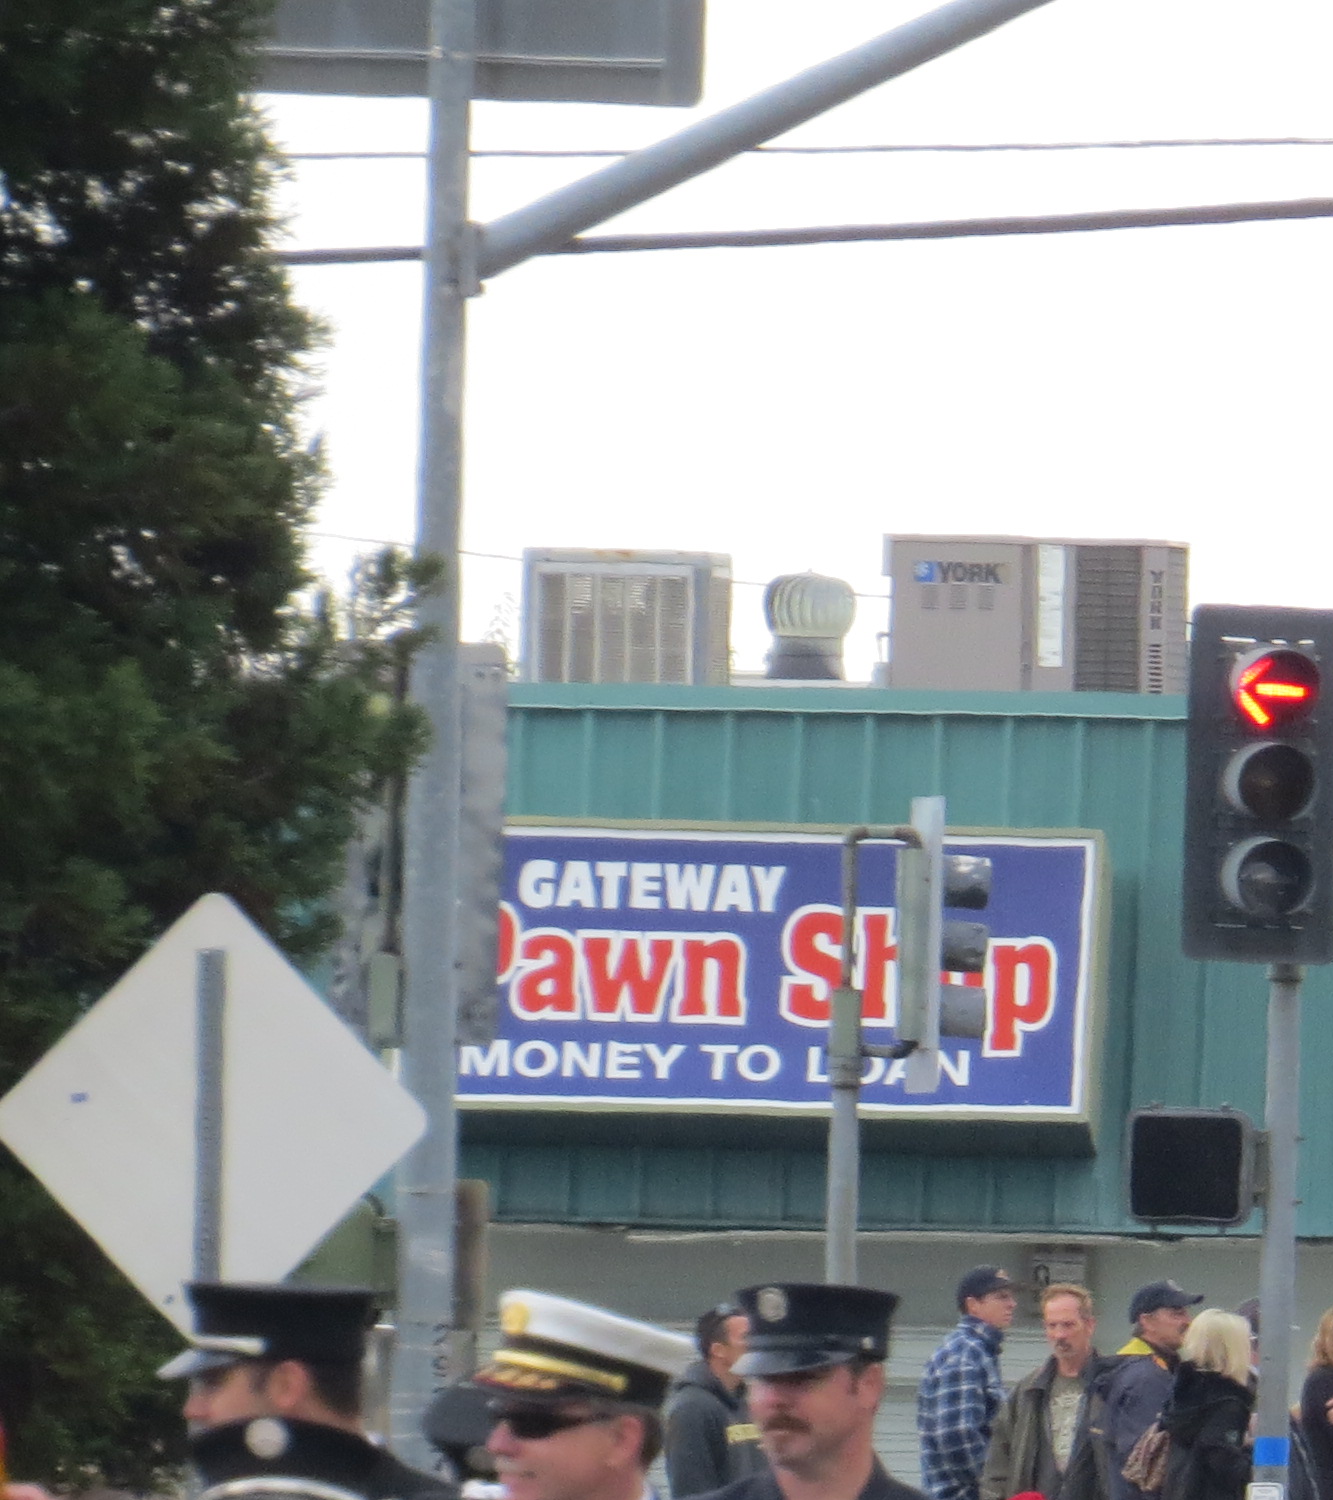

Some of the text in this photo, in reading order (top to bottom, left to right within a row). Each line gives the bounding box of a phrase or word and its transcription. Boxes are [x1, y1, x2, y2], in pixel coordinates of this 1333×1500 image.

[938, 561, 1003, 584] YORK
[517, 859, 787, 913] GATEWAY
[497, 902, 1057, 1058] awn Shp
[459, 1039, 687, 1080] MONEY
[700, 1044, 781, 1082] TO
